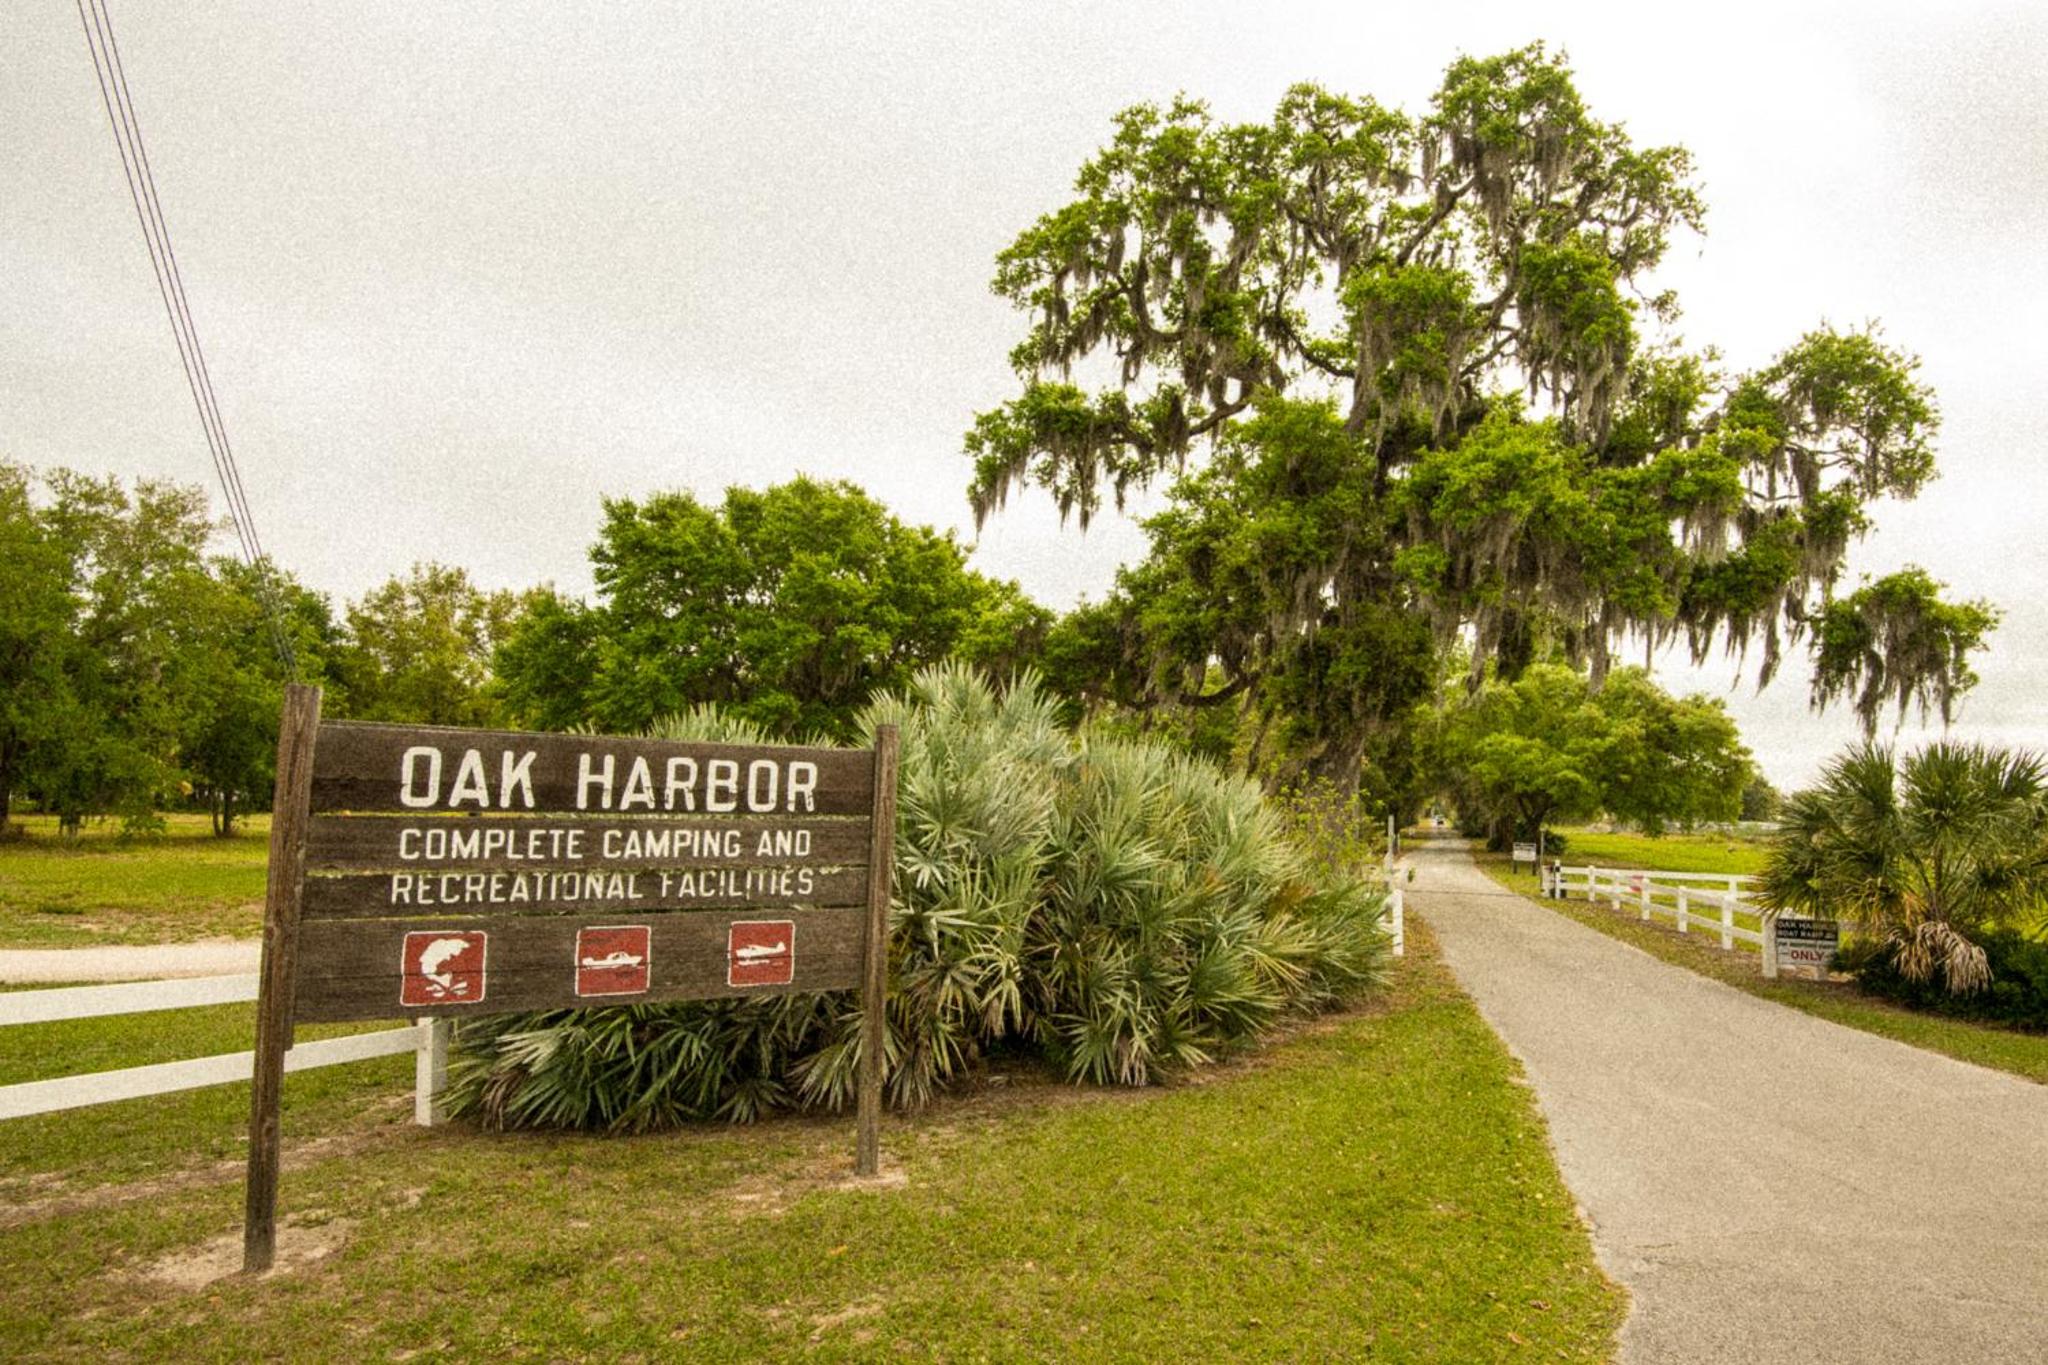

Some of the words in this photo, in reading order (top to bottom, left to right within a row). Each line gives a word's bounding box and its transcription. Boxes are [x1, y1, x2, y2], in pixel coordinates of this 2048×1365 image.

[400, 746, 537, 808] OAK
[576, 753, 818, 813] HARBOR
[399, 828, 585, 860] COMPLETE
[602, 829, 741, 859] CAMPING
[756, 829, 811, 857] AND
[391, 872, 644, 905] RECREATIONAL
[661, 868, 814, 901] FACILITIES
[1791, 950, 1825, 961] ONLY
